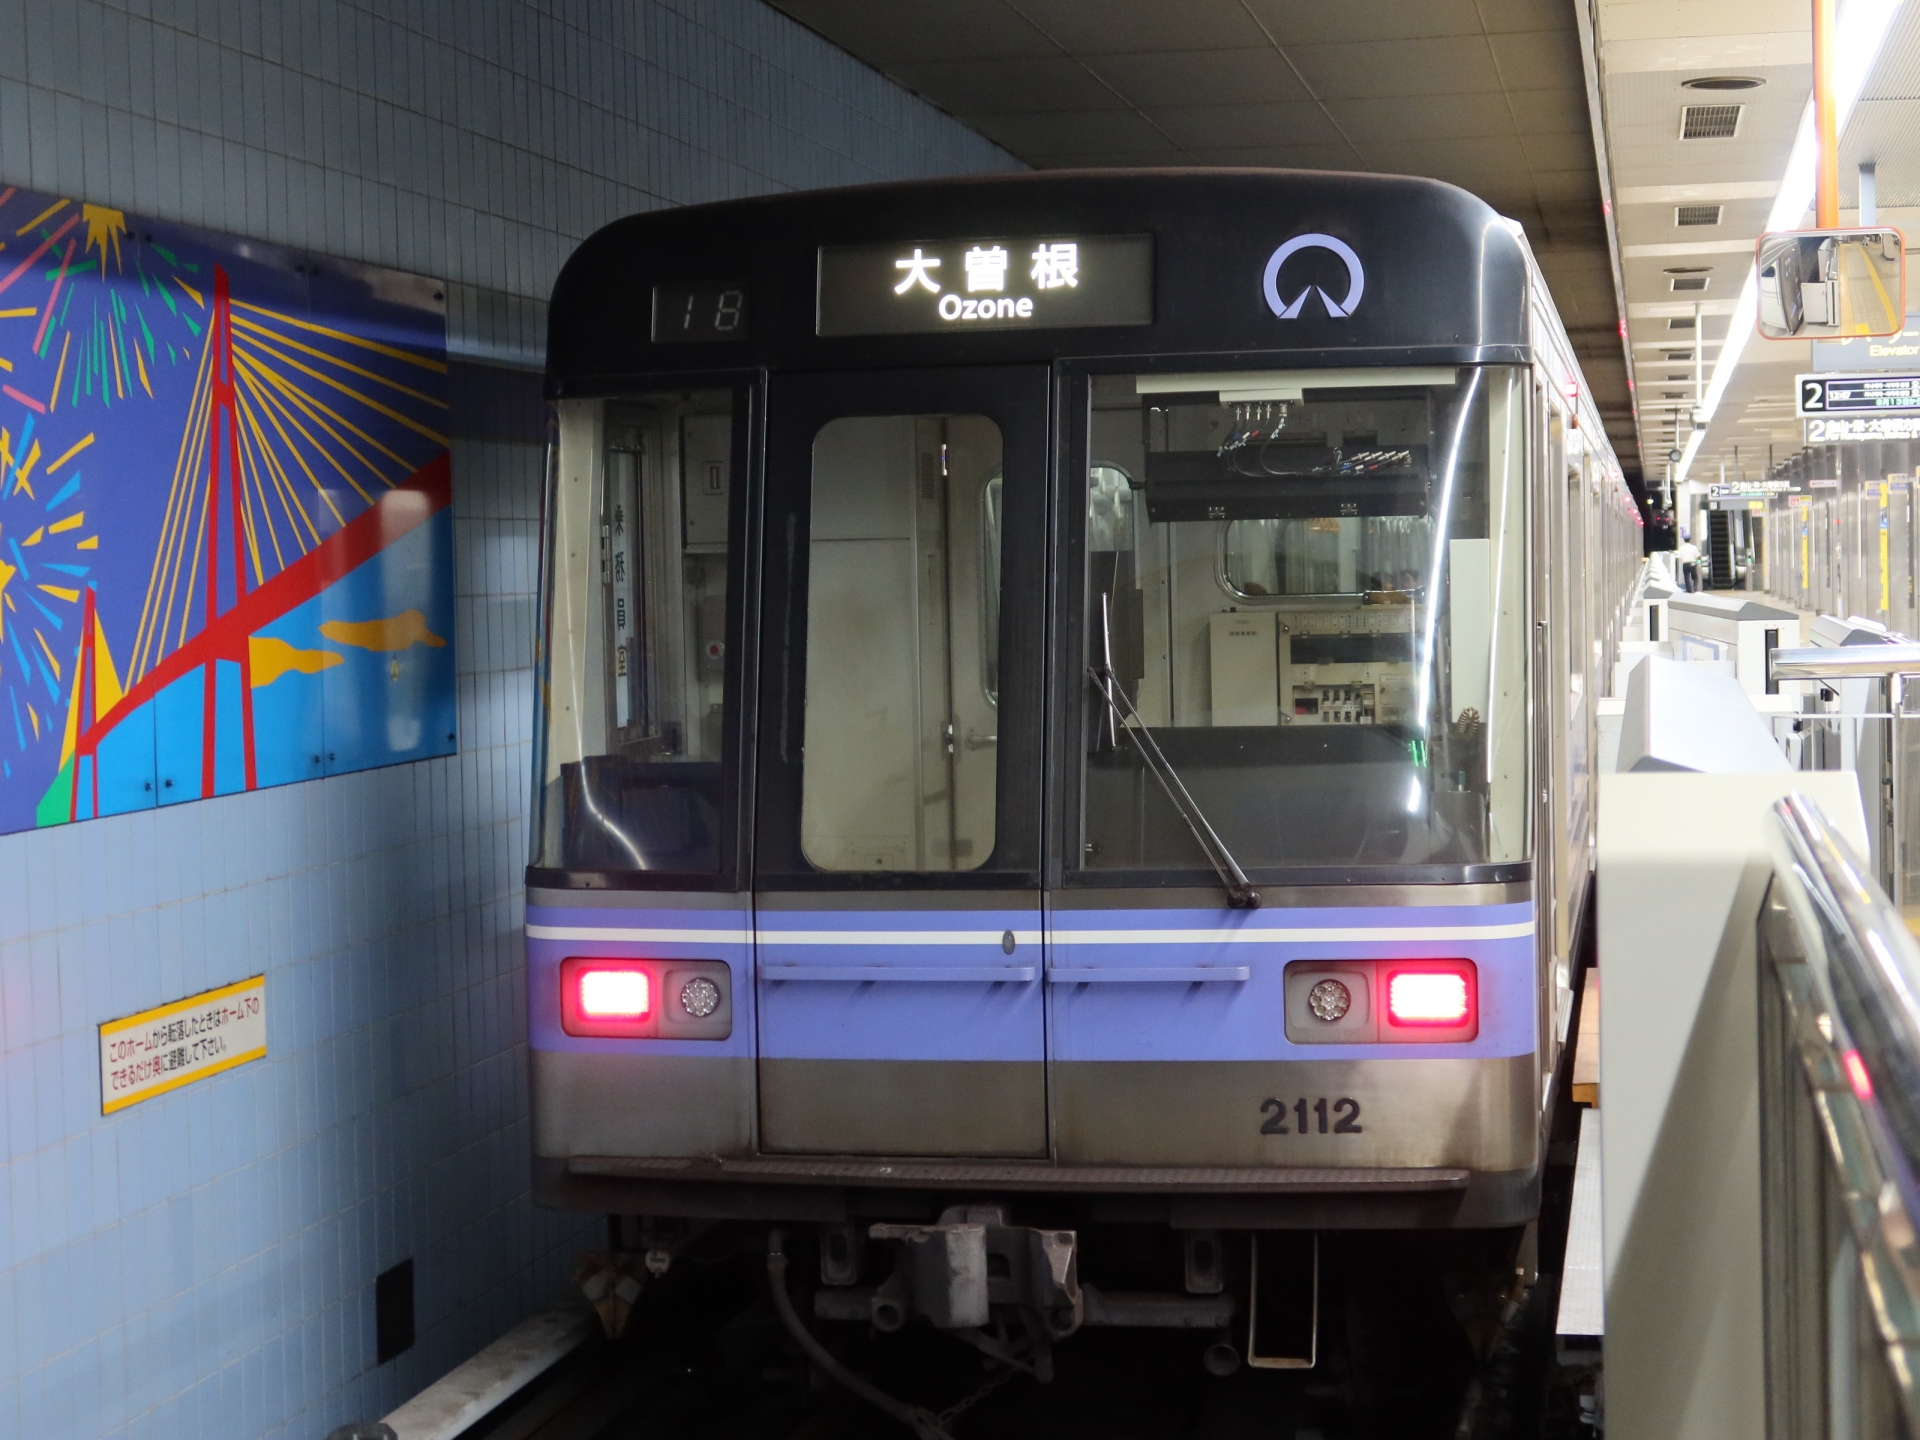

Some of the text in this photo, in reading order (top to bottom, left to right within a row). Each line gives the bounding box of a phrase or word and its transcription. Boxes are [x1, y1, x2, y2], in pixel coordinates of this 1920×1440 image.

[893, 243, 1080, 296] 大曽根
[682, 289, 744, 332] 18
[938, 294, 1034, 320] Ozone
[1869, 344, 1920, 357] Elevator
[1804, 382, 1824, 409] 2
[1809, 419, 1826, 442] 2
[1732, 481, 1740, 493] 2
[109, 996, 260, 1064] このホームから転落したときはホーム下の
[110, 1035, 228, 1091] できるだけ奥に避難して下さい。
[1260, 1097, 1363, 1135] 2112
